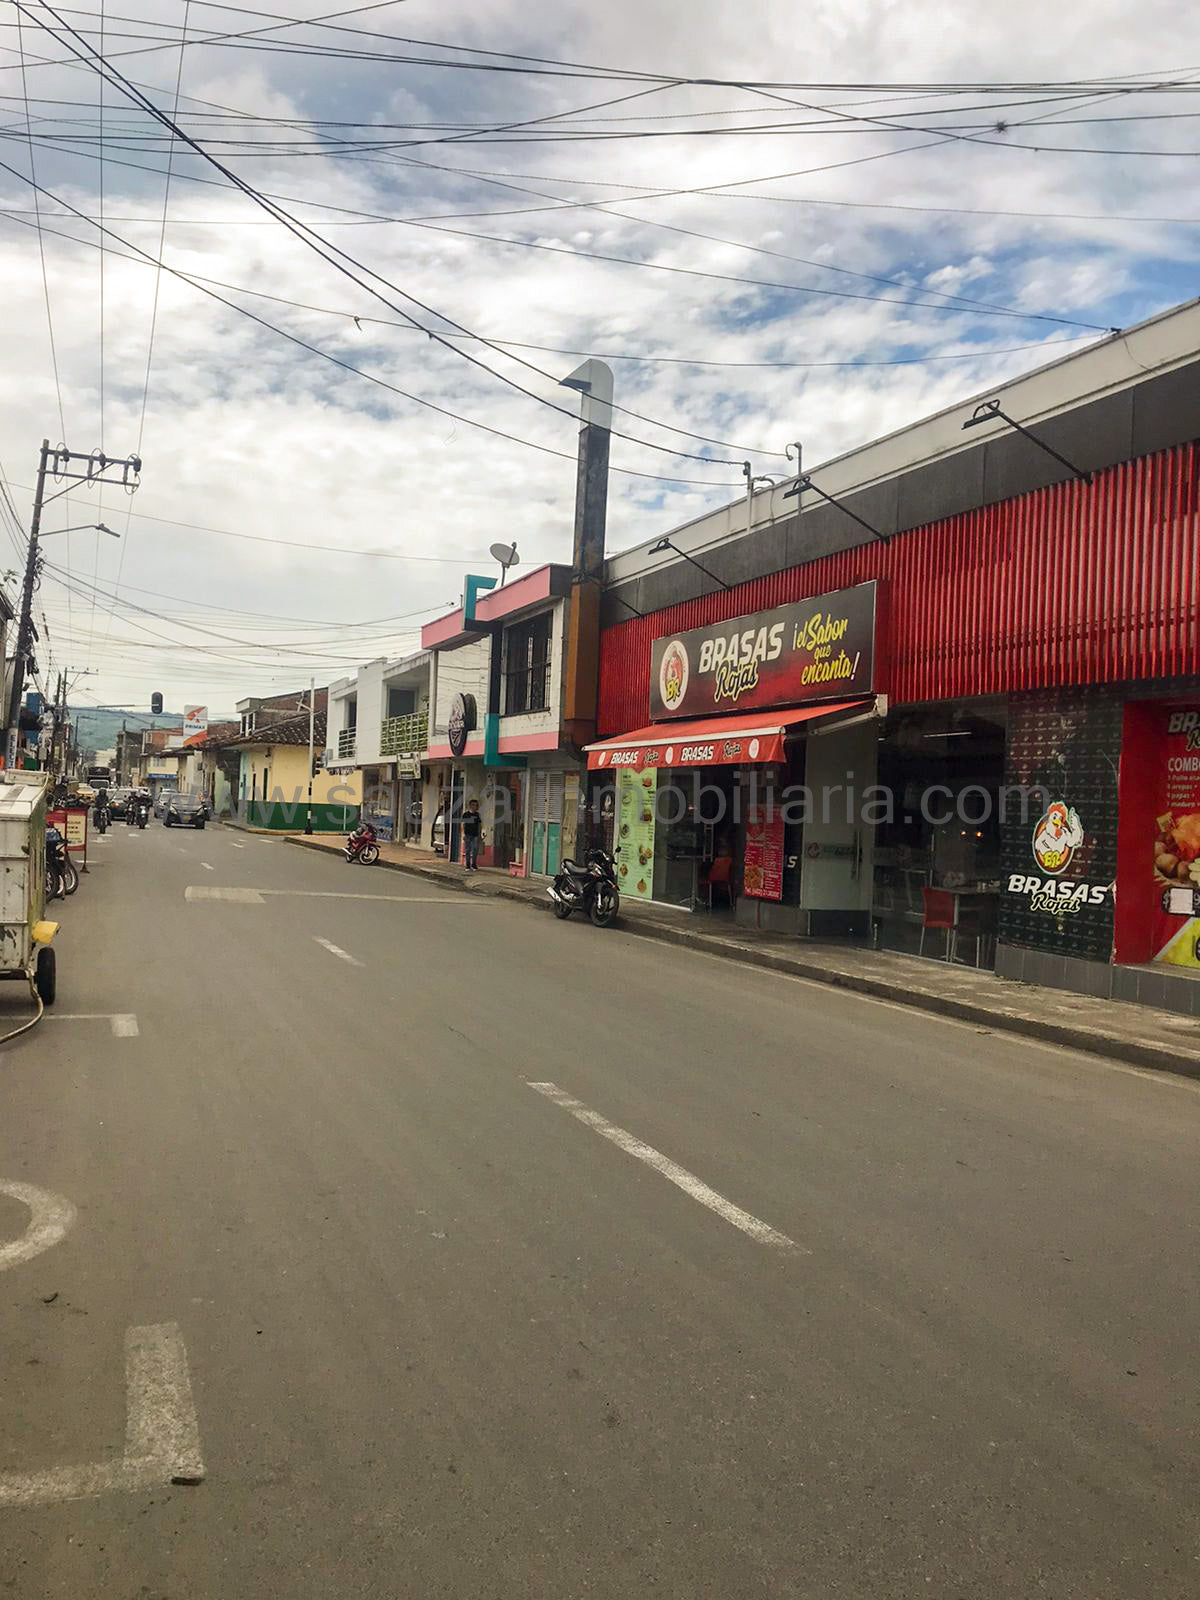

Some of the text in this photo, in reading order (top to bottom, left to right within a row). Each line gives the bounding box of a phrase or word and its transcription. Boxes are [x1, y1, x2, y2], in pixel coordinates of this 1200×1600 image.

[698, 621, 786, 674] BRASAS
[806, 612, 849, 652] Sabor
[801, 649, 861, 686] encanta!
[813, 644, 832, 665] que
[713, 658, 759, 703] Rojas
[610, 750, 640, 765] BRASAS
[681, 745, 715, 762] BRASAS
[1007, 874, 1108, 905] BRASAS
[1030, 890, 1081, 915] Rojas
